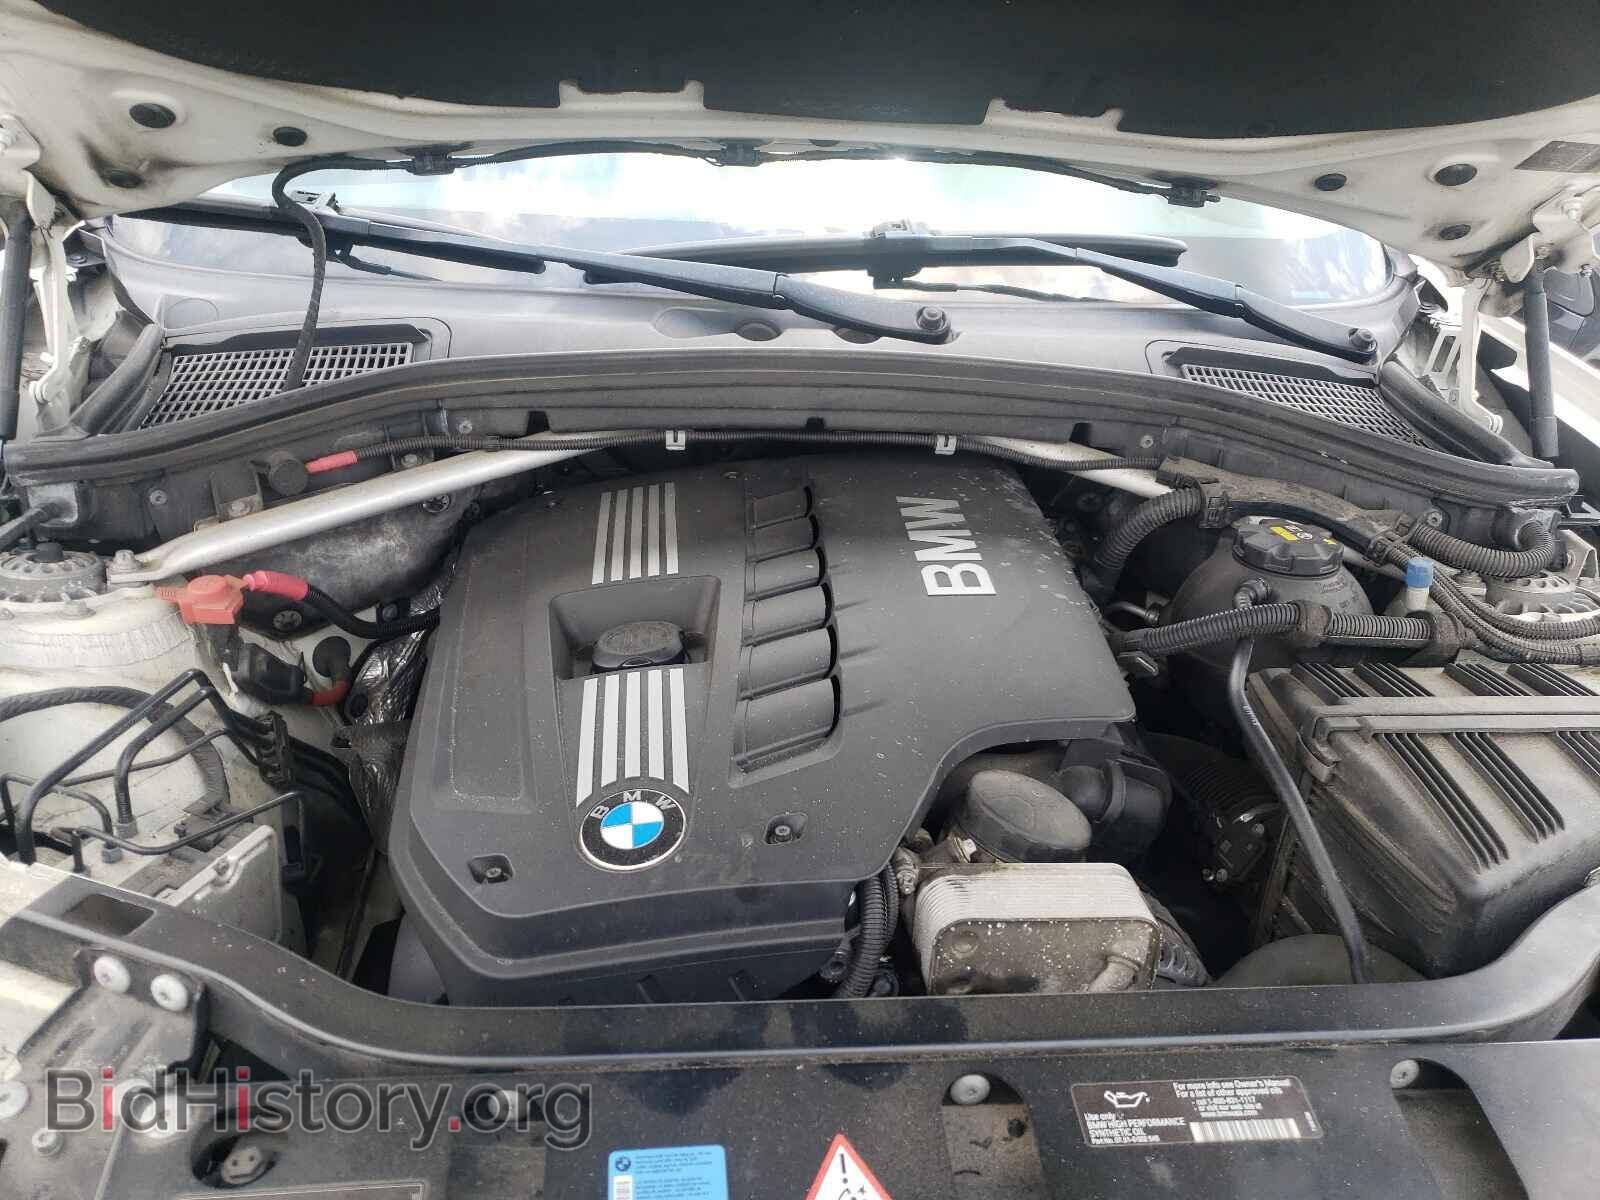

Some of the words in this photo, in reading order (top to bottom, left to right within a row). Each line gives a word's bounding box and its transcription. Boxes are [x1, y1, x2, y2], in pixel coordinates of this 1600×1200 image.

[896, 496, 997, 595] BMW
[590, 790, 677, 820] BMW
[1173, 1081, 1186, 1091] For
[1176, 1090, 1188, 1098] For
[1084, 1112, 1099, 1121] Use
[1128, 1117, 1186, 1128] PERFORMANCE
[1089, 1128, 1132, 1138] SYNTHETIC
[1132, 1127, 1146, 1136] OIL
